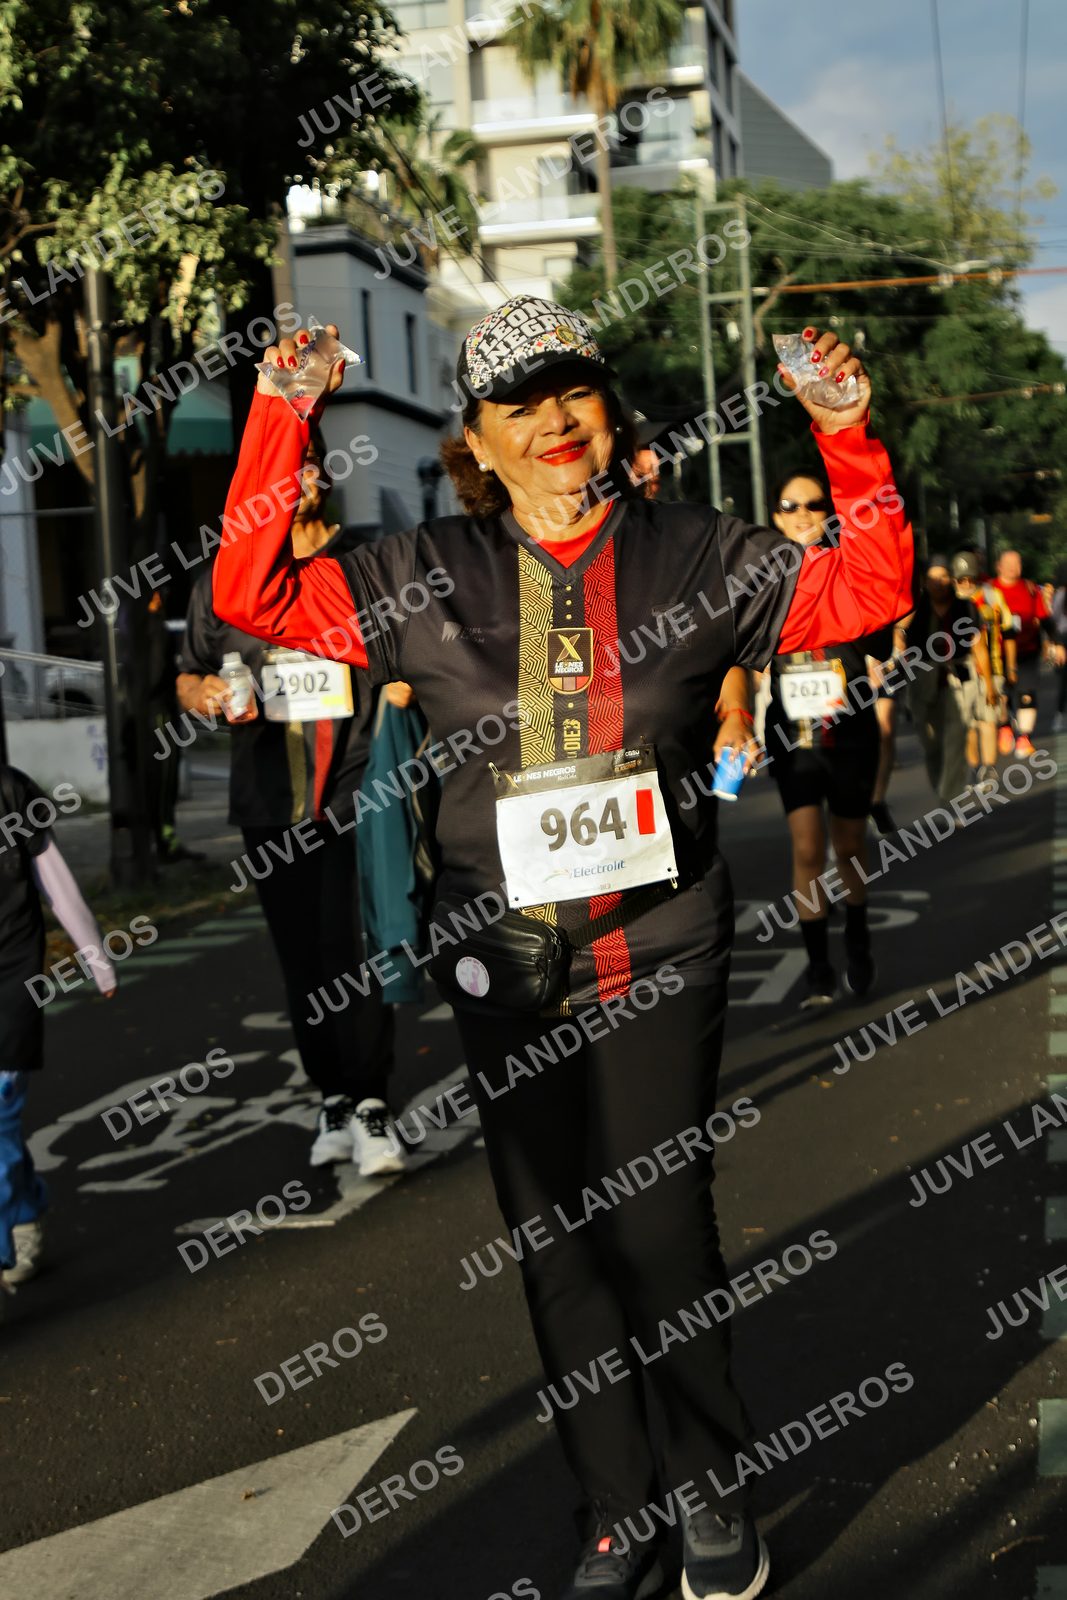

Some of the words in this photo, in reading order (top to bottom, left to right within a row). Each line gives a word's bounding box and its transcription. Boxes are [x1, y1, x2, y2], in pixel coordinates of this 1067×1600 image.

[486, 314, 589, 368] NEGROS
[274, 671, 330, 696] 2902
[789, 680, 830, 698] 2621
[543, 765, 576, 778] NEGROS
[540, 797, 627, 852] 964
[573, 860, 626, 878] Electrolit
